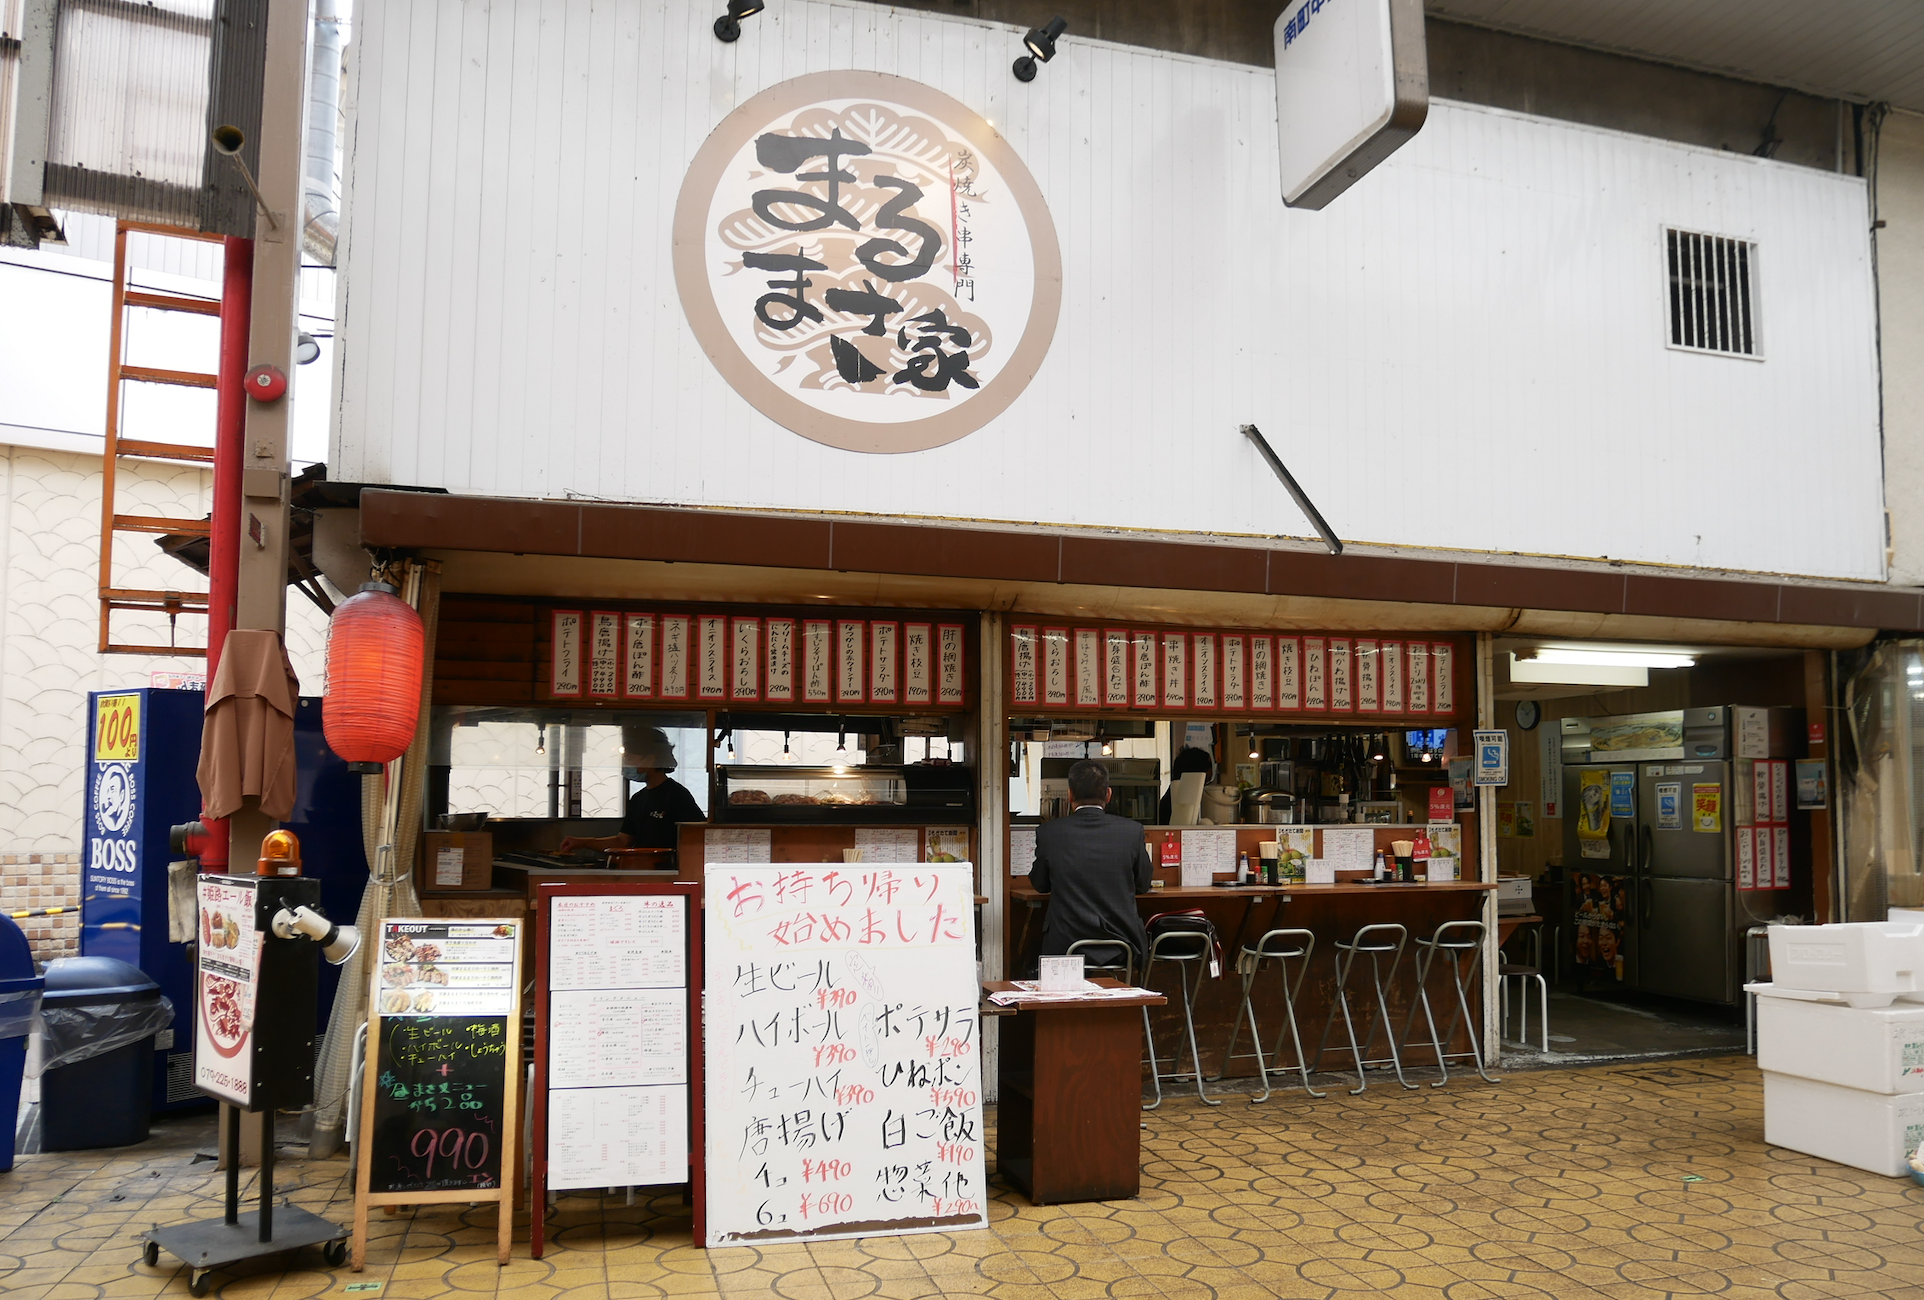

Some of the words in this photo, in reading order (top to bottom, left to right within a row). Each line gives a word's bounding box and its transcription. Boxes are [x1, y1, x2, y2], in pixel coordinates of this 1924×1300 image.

[953, 149, 977, 302] 炭焼き串専門
[562, 616, 577, 677] ポテトフライ
[597, 615, 614, 657] 鳥唐揚げ
[707, 619, 718, 681] オニオンスライス
[781, 622, 791, 676] クリームチーズの
[878, 626, 892, 682] ポテトサラダ
[739, 623, 751, 687] いくらおろし
[909, 634, 924, 680] 焼き枝豆
[942, 629, 957, 683] 肝の網焼き
[1200, 636, 1208, 693] オニオンスライス
[1228, 639, 1240, 690] ポテトサラダ
[1281, 643, 1293, 687] 焼き枝豆
[1309, 653, 1321, 692] ひねぽん
[556, 682, 578, 691] 290円
[628, 684, 650, 693] 390円
[664, 686, 685, 694] 490円
[702, 686, 722, 694] 190円
[734, 687, 757, 696] 390円
[769, 684, 790, 693] 290円
[873, 687, 894, 696] 390円
[908, 686, 928, 696] 190円
[90, 838, 137, 873] BOSS
[726, 870, 940, 918] お持ち帰り
[386, 924, 429, 933] TAKEOUT
[767, 902, 966, 946] 始めました
[732, 959, 842, 998] 生ビール
[816, 987, 858, 1010] ¥390
[405, 1025, 454, 1040] 生ビール
[735, 1003, 849, 1048] ハイボール
[875, 1002, 974, 1049] ポテサラ
[407, 1037, 464, 1053] ハイボール
[407, 1051, 456, 1066] チューハイ
[812, 1043, 858, 1068] ¥390
[200, 1066, 248, 1095] 079-225-1888
[740, 1066, 843, 1103] チューハイ
[875, 1057, 974, 1089] ひねポン
[836, 1084, 875, 1107] ¥390
[929, 1086, 976, 1108] ¥590
[738, 1107, 853, 1162] 唐揚げ
[881, 1106, 979, 1150] 白ご飯
[410, 1127, 490, 1179] 990
[936, 1140, 974, 1163] ¥190
[801, 1157, 852, 1185] ¥490
[798, 1191, 854, 1220] ¥690
